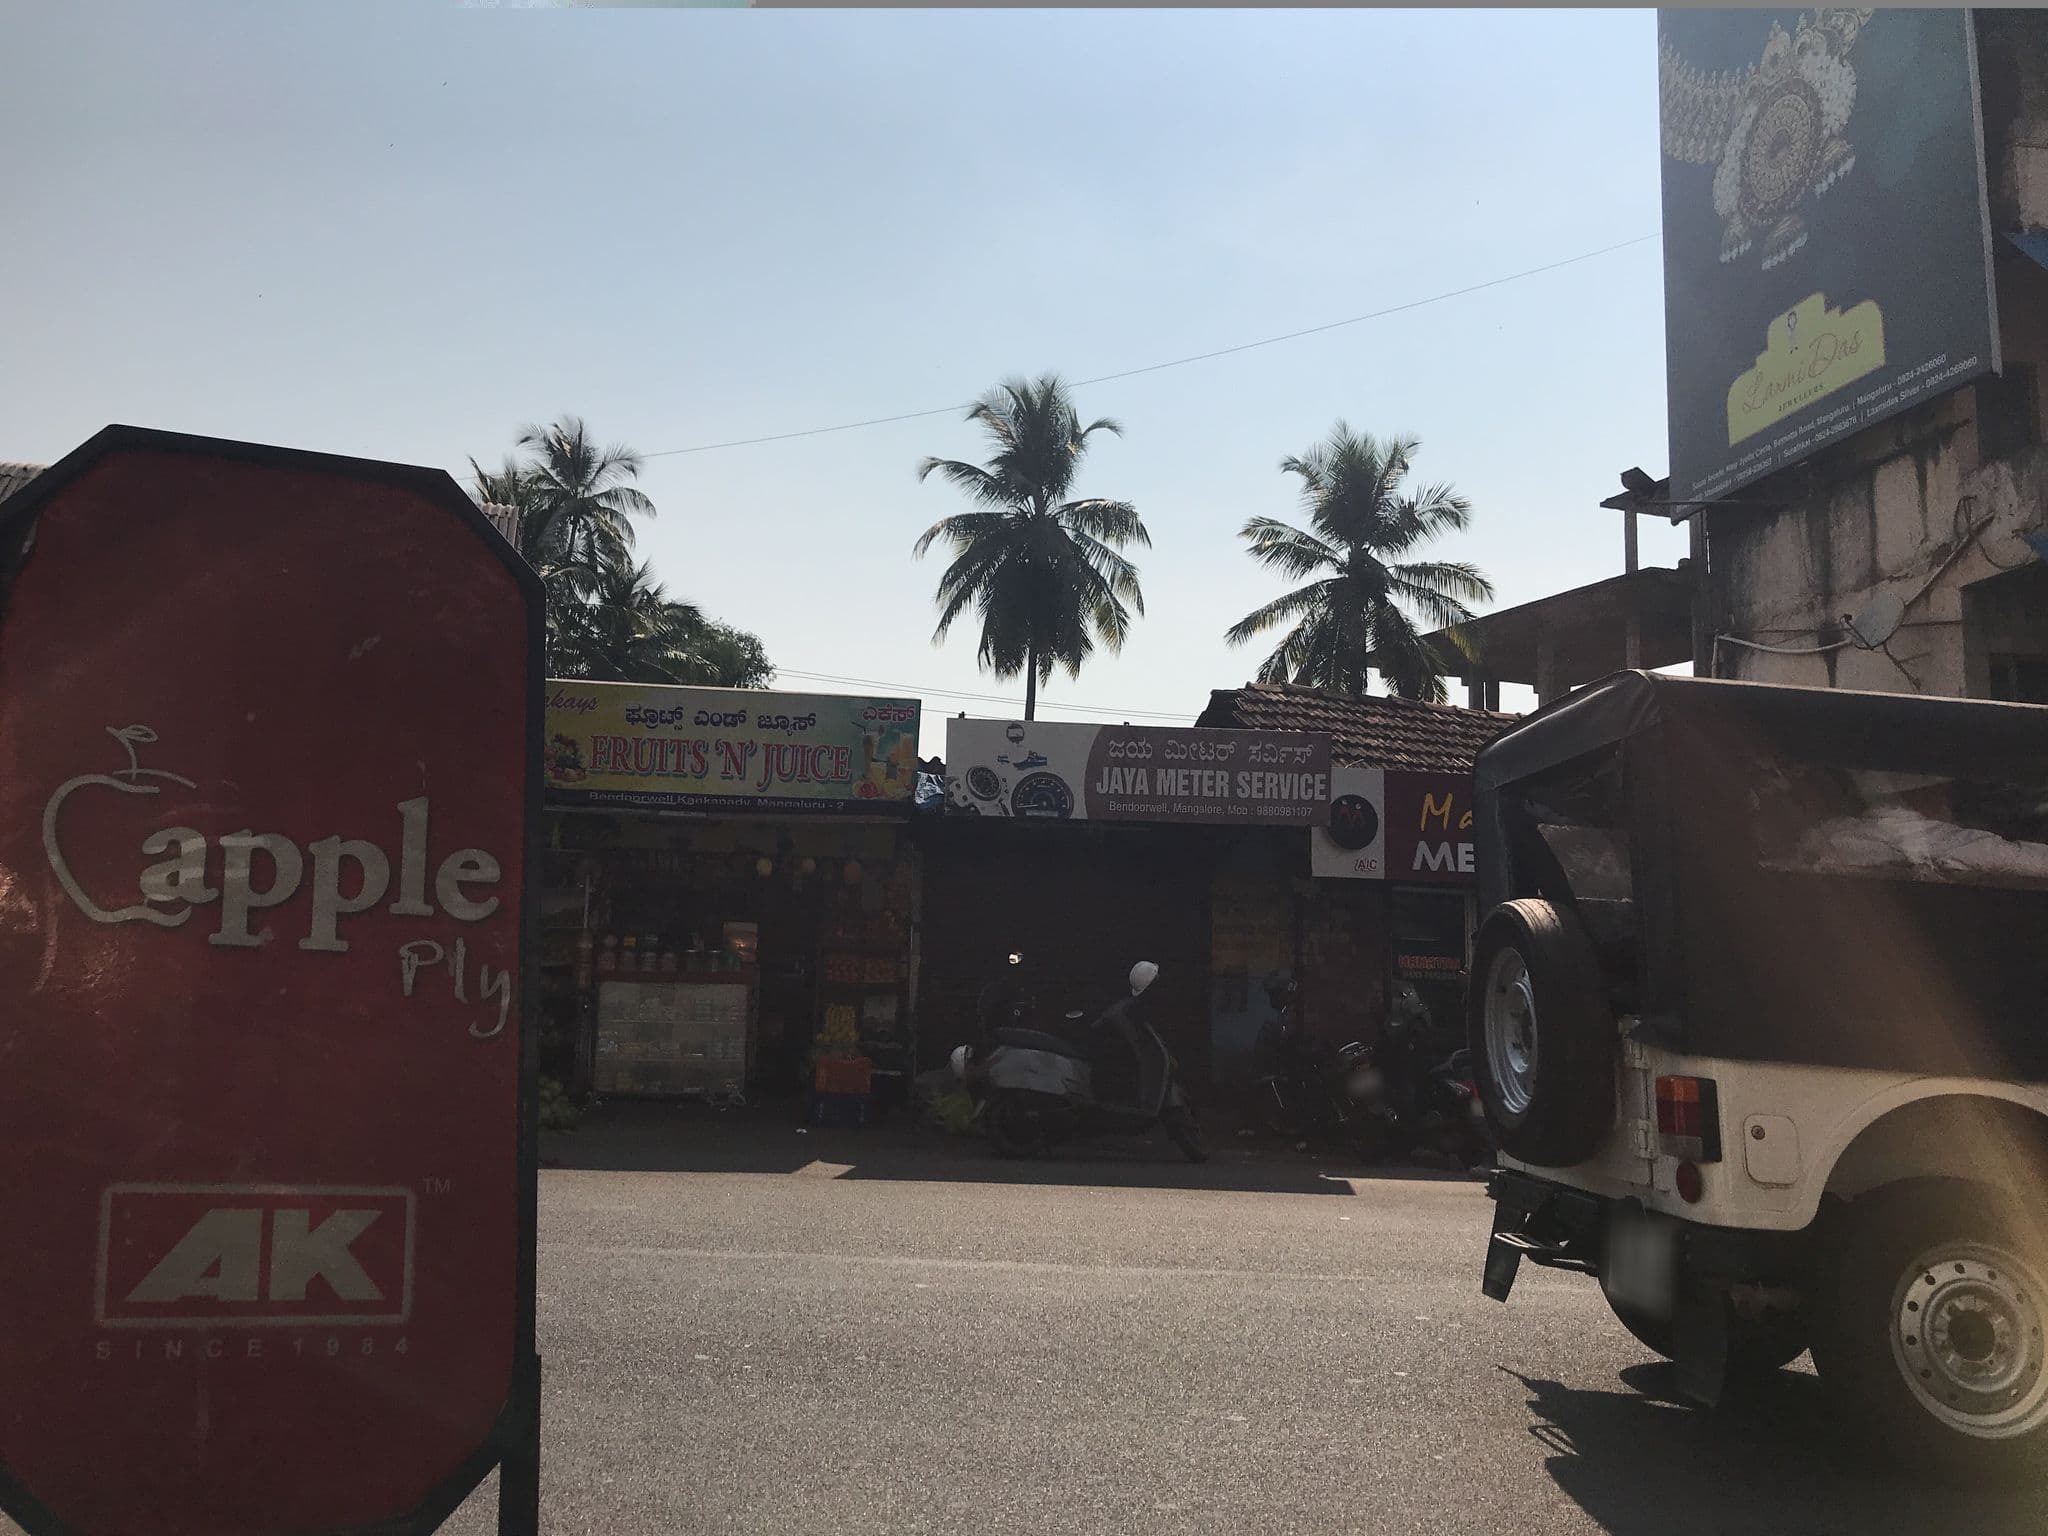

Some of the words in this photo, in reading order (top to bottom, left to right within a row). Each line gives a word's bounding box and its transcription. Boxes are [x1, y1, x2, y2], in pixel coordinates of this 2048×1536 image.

[545, 688, 600, 715] kays
[588, 735, 708, 778] FRUITS
[756, 742, 853, 793] JUICE
[1096, 767, 1149, 795] JAYA
[1156, 768, 1230, 798] METER
[1236, 771, 1327, 801] SERVICE
[138, 797, 502, 952] apple
[400, 937, 511, 1038] Ply
[125, 1208, 384, 1301] AK
[95, 1339, 263, 1360] SINCE
